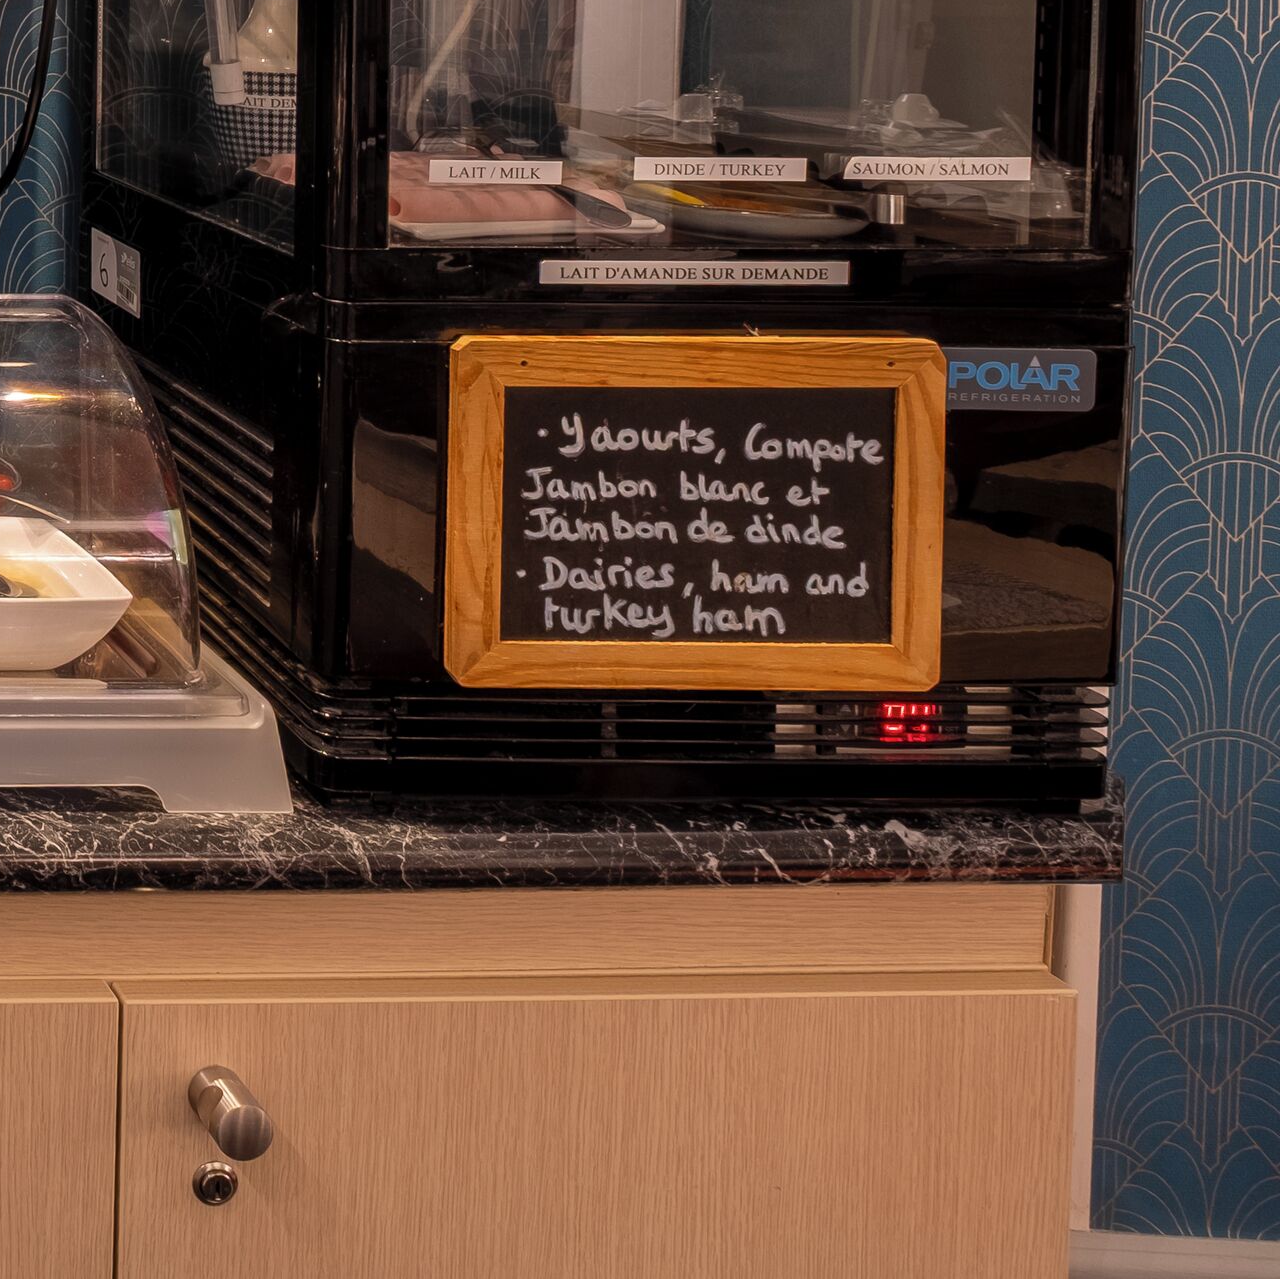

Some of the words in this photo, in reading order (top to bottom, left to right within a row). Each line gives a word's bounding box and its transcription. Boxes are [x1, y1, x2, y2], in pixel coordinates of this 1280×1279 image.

[243, 97, 266, 108] AIT
[448, 166, 487, 179] LAIT
[500, 167, 541, 179] MILK
[653, 163, 705, 176] DINDE
[719, 163, 786, 176] TURKEY
[852, 162, 926, 175] SAUMON
[938, 163, 1010, 176] SALMON
[559, 266, 600, 280] LAIT
[605, 266, 697, 280] D'AMANDE
[702, 267, 736, 280] SUR
[741, 267, 829, 281] DEMANDE
[948, 358, 1081, 392] POLAR
[947, 392, 1081, 404] REFRIGERATION
[558, 412, 727, 465] Yaourts,
[520, 466, 658, 503] Jambon
[679, 471, 770, 506] blanc
[786, 478, 831, 507] et
[523, 506, 678, 545] Jambon
[687, 507, 735, 543] de
[744, 513, 847, 550] dinde
[709, 559, 790, 595] ham
[805, 561, 870, 598] and
[692, 595, 787, 637] ham
